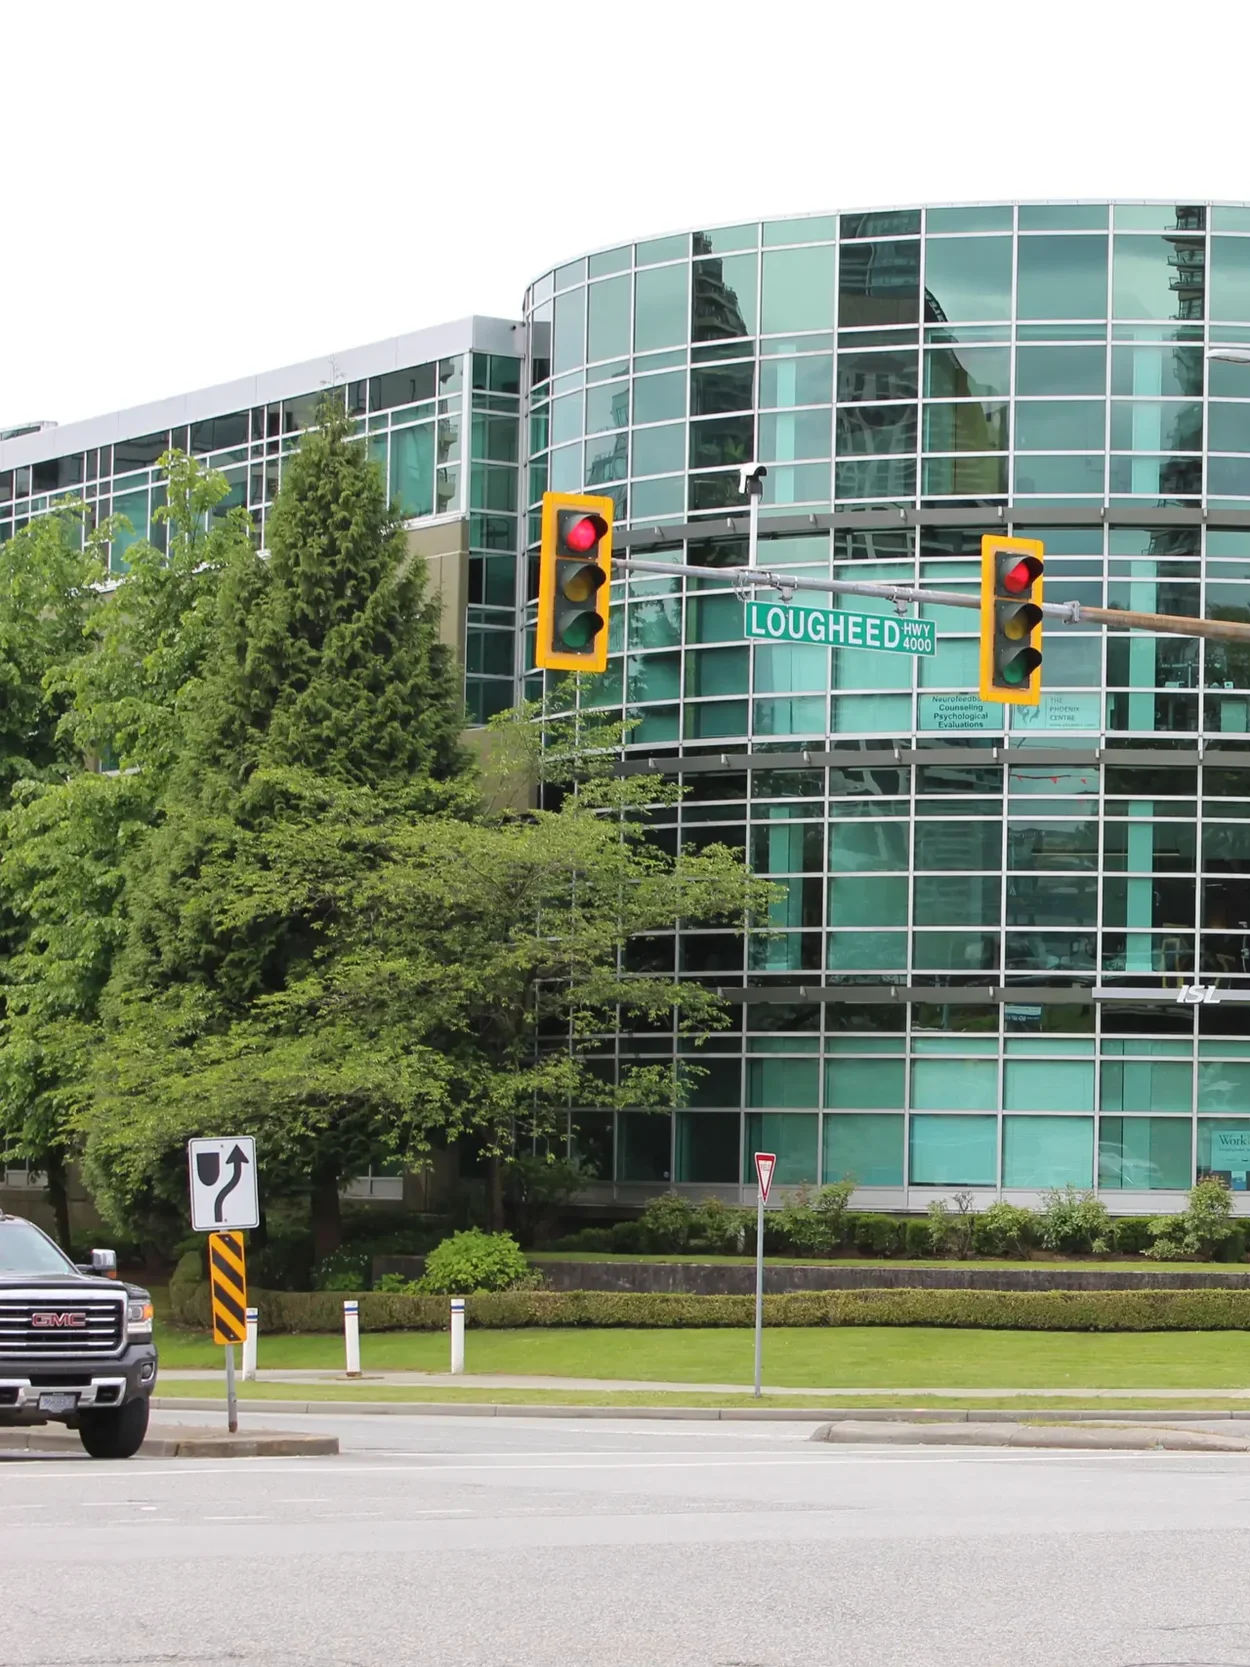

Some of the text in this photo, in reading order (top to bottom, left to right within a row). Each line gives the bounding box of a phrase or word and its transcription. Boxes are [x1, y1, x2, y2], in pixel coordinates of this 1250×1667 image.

[751, 605, 931, 649] LOUGHEED HWY
[903, 637, 932, 652] 4000
[932, 695, 981, 703] Neurofeedb
[938, 703, 984, 712] Counseling
[933, 712, 988, 721] Psychological
[938, 721, 984, 729] Evaluations
[1176, 985, 1221, 1004] ISL
[32, 1312, 86, 1327] GMC
